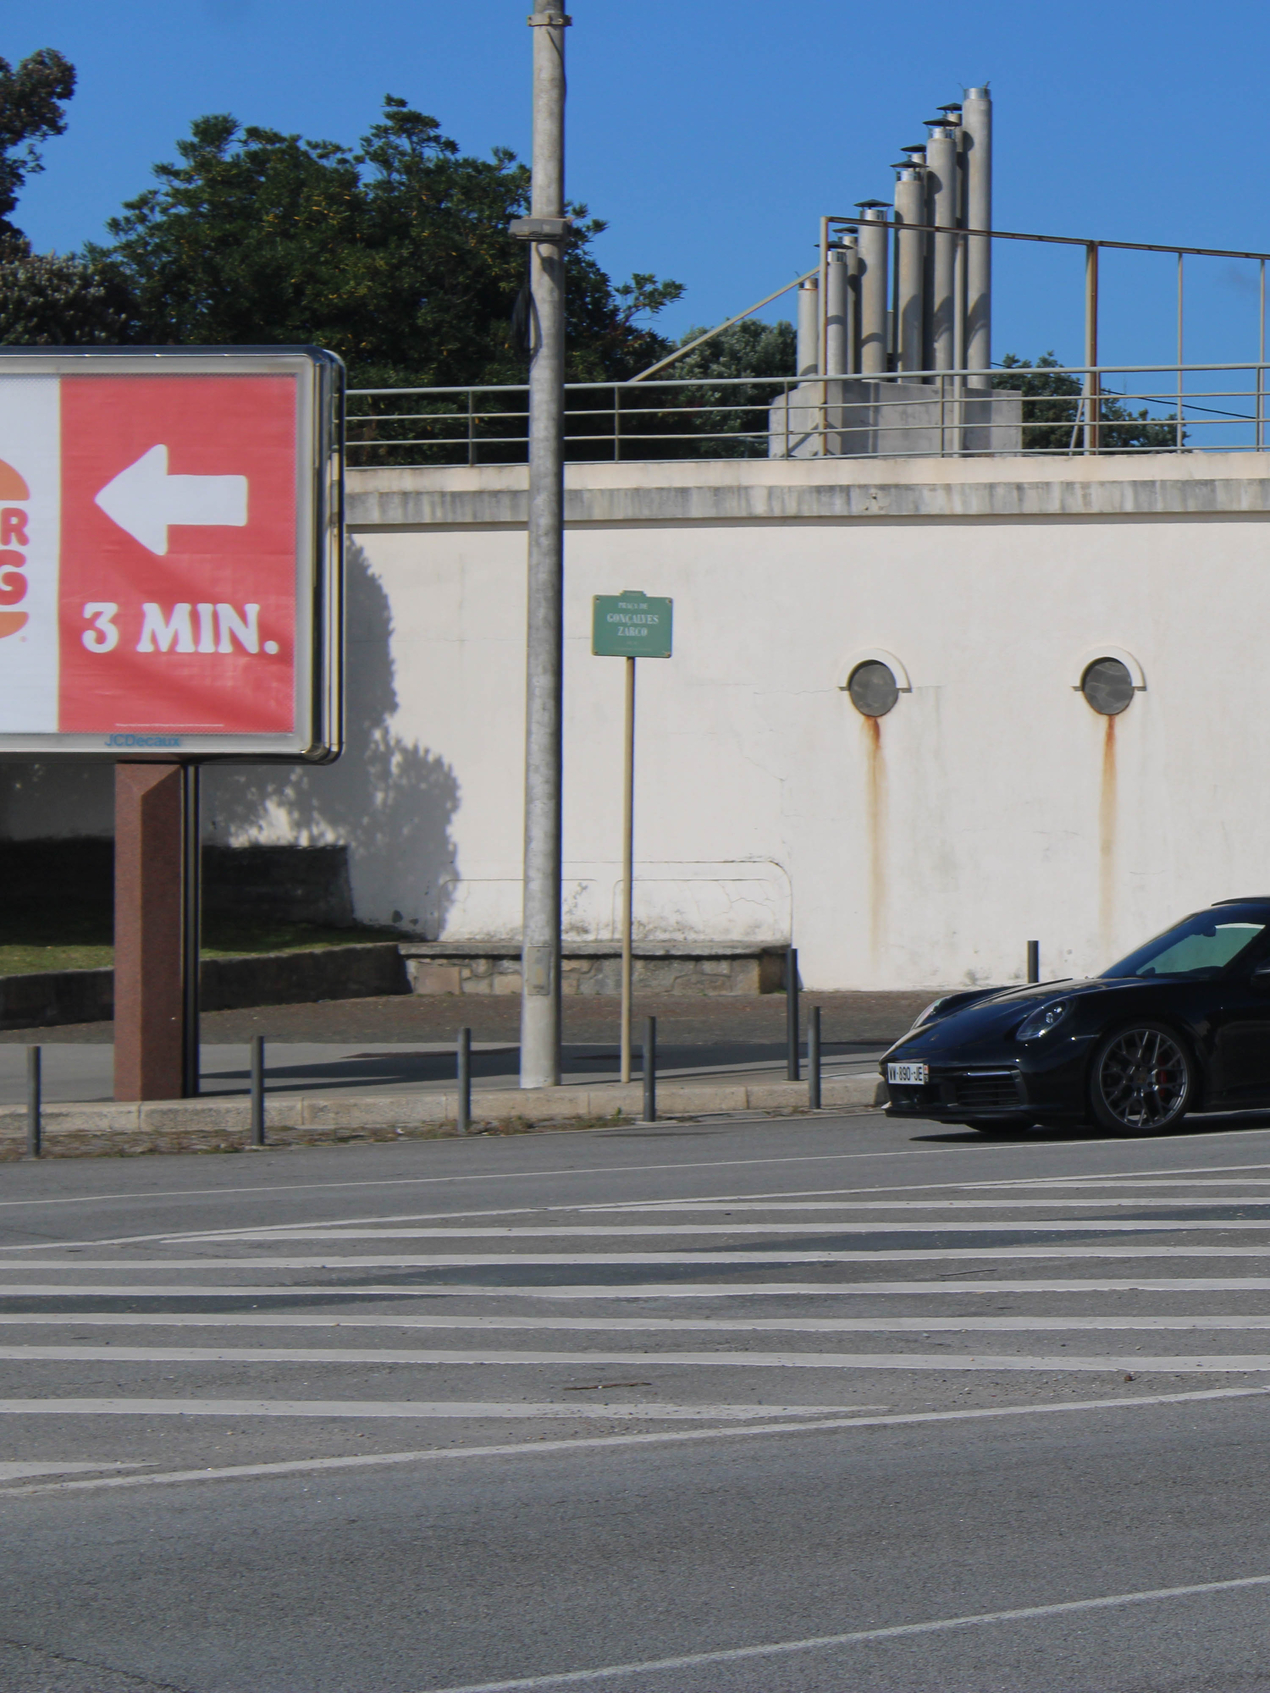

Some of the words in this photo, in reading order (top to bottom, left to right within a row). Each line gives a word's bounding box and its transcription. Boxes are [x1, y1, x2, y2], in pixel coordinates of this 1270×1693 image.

[606, 613, 659, 626] GONÇALVES
[82, 602, 119, 654] 3
[136, 602, 280, 654] MIN.
[617, 626, 648, 637] ZARCO
[104, 733, 182, 747] JCDecaux
